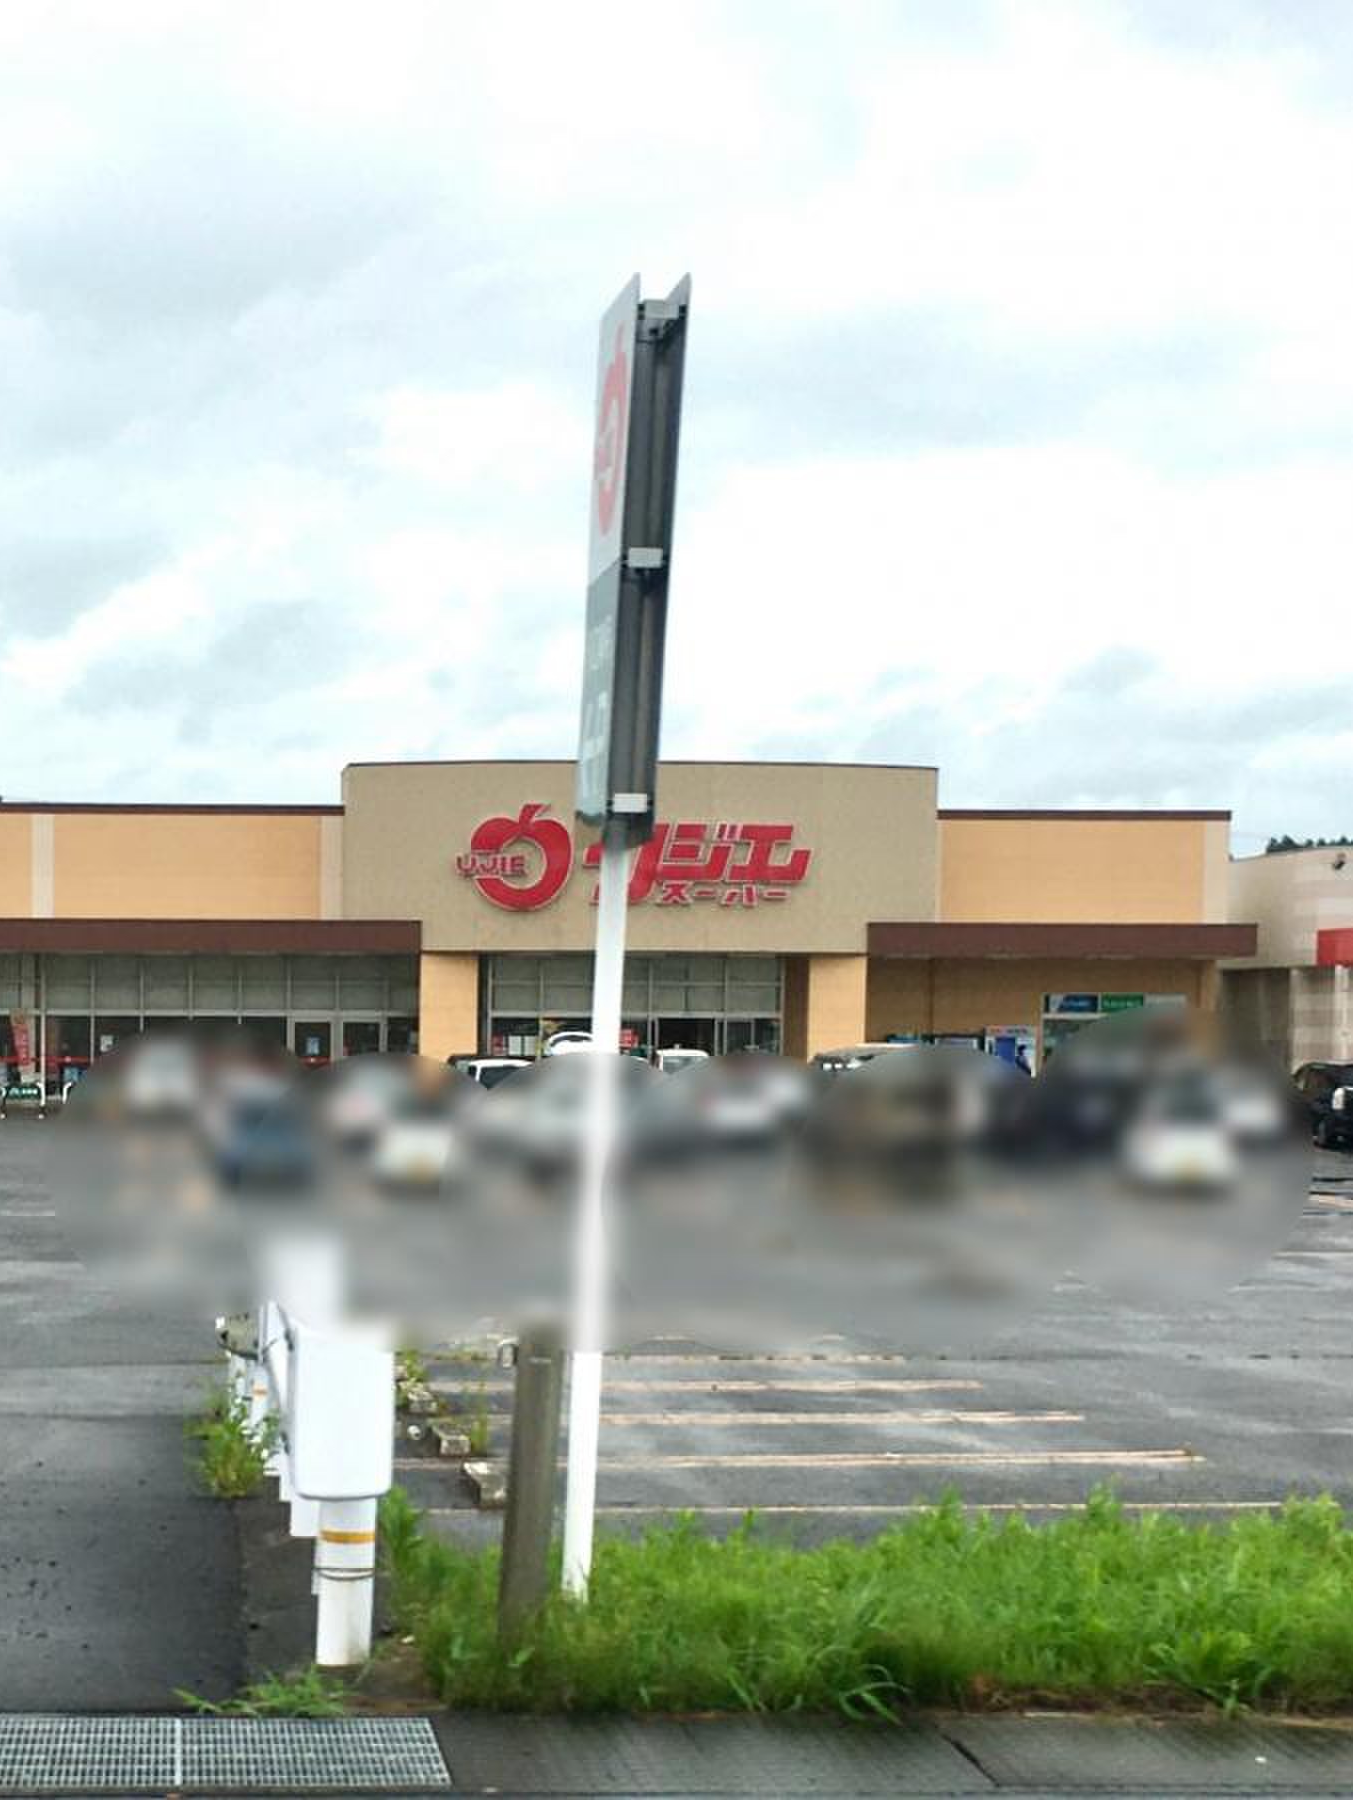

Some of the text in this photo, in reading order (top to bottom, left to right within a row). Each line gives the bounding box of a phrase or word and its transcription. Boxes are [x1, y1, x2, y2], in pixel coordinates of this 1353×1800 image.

[455, 855, 527, 876] UJIE
[656, 880, 791, 907] スーパー
